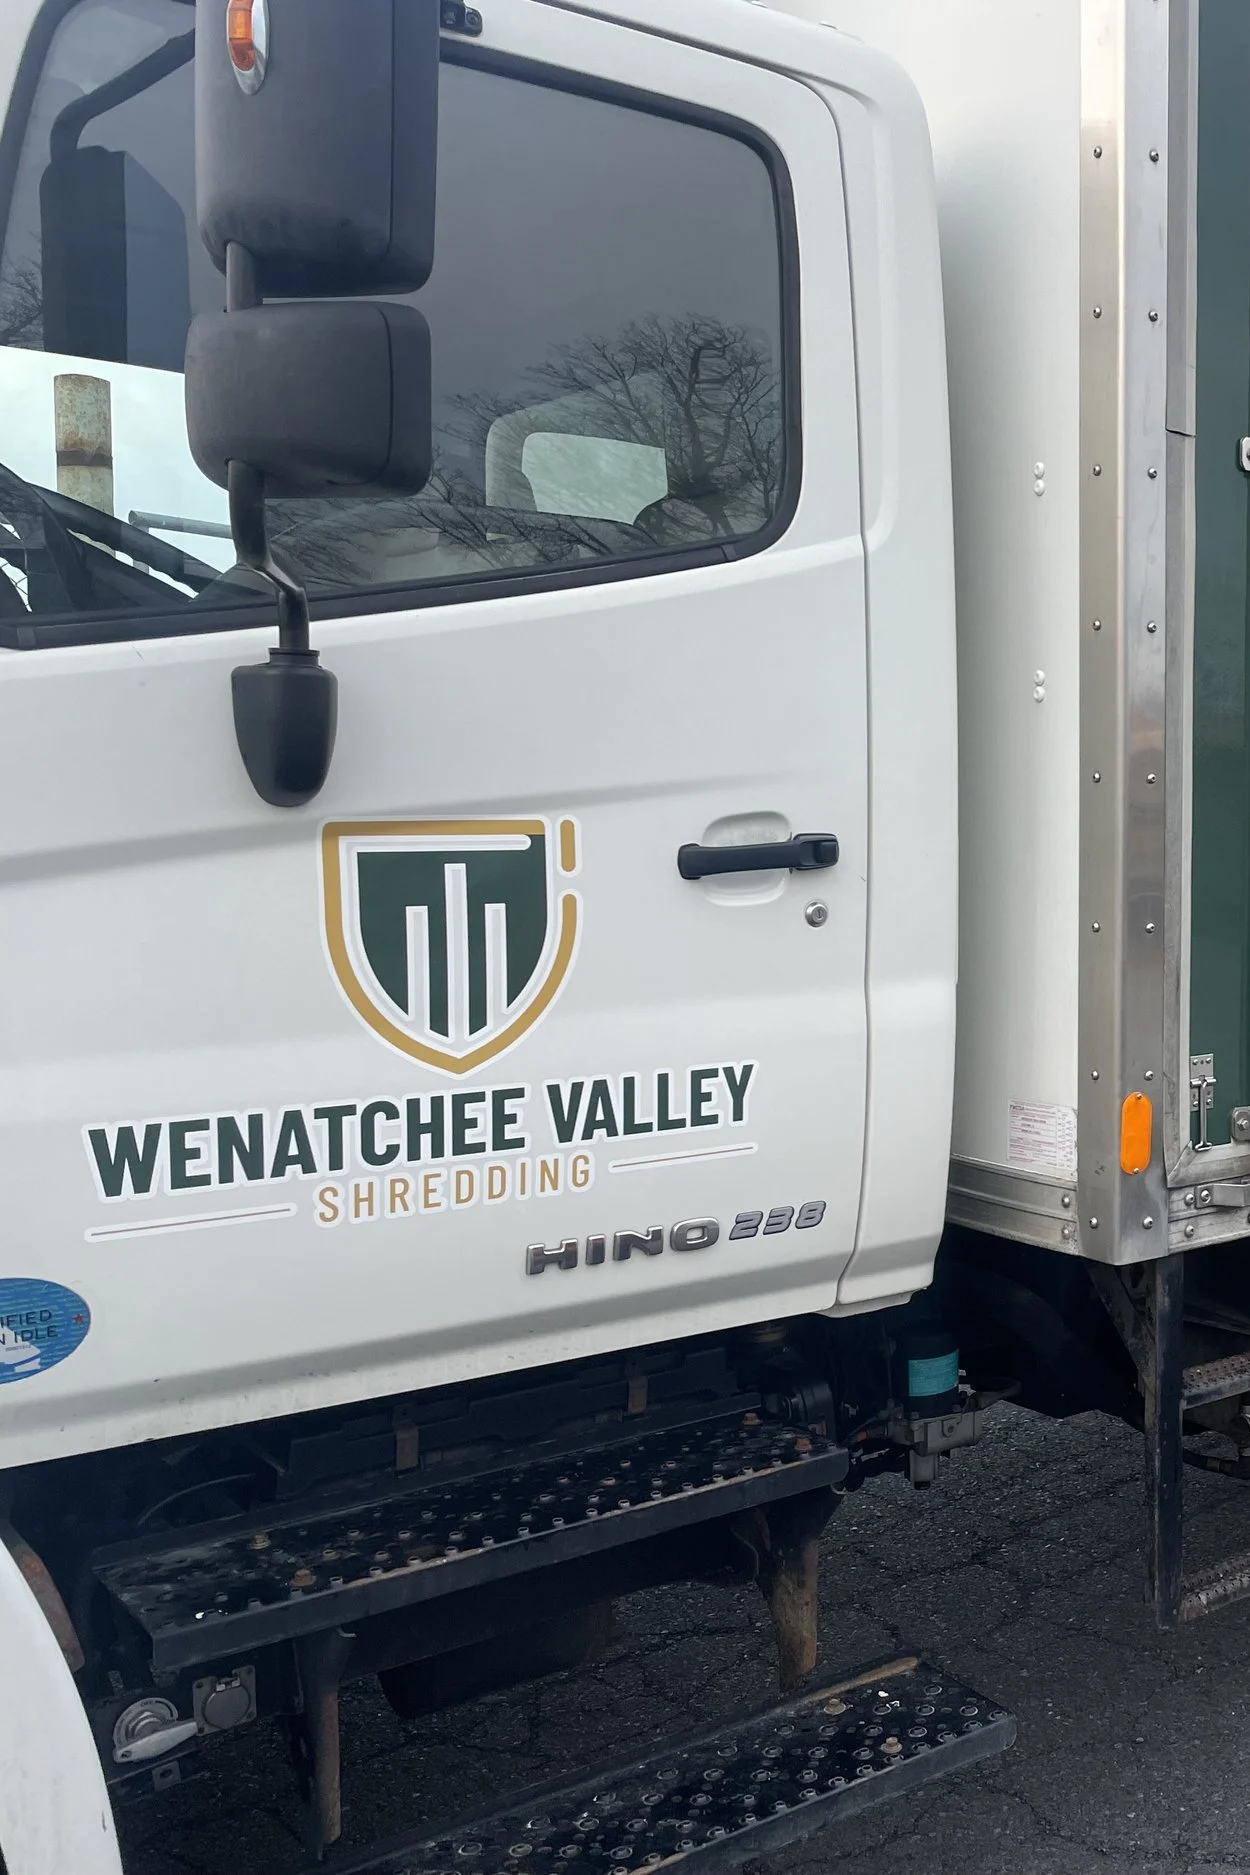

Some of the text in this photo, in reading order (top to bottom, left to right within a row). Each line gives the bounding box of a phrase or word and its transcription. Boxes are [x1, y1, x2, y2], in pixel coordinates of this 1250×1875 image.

[88, 1063, 755, 1198] WENATCHEE VALLEY
[319, 1155, 591, 1224] SHREDDING
[525, 1200, 827, 1276] HINO 238
[14, 1325, 58, 1344] IDLE
